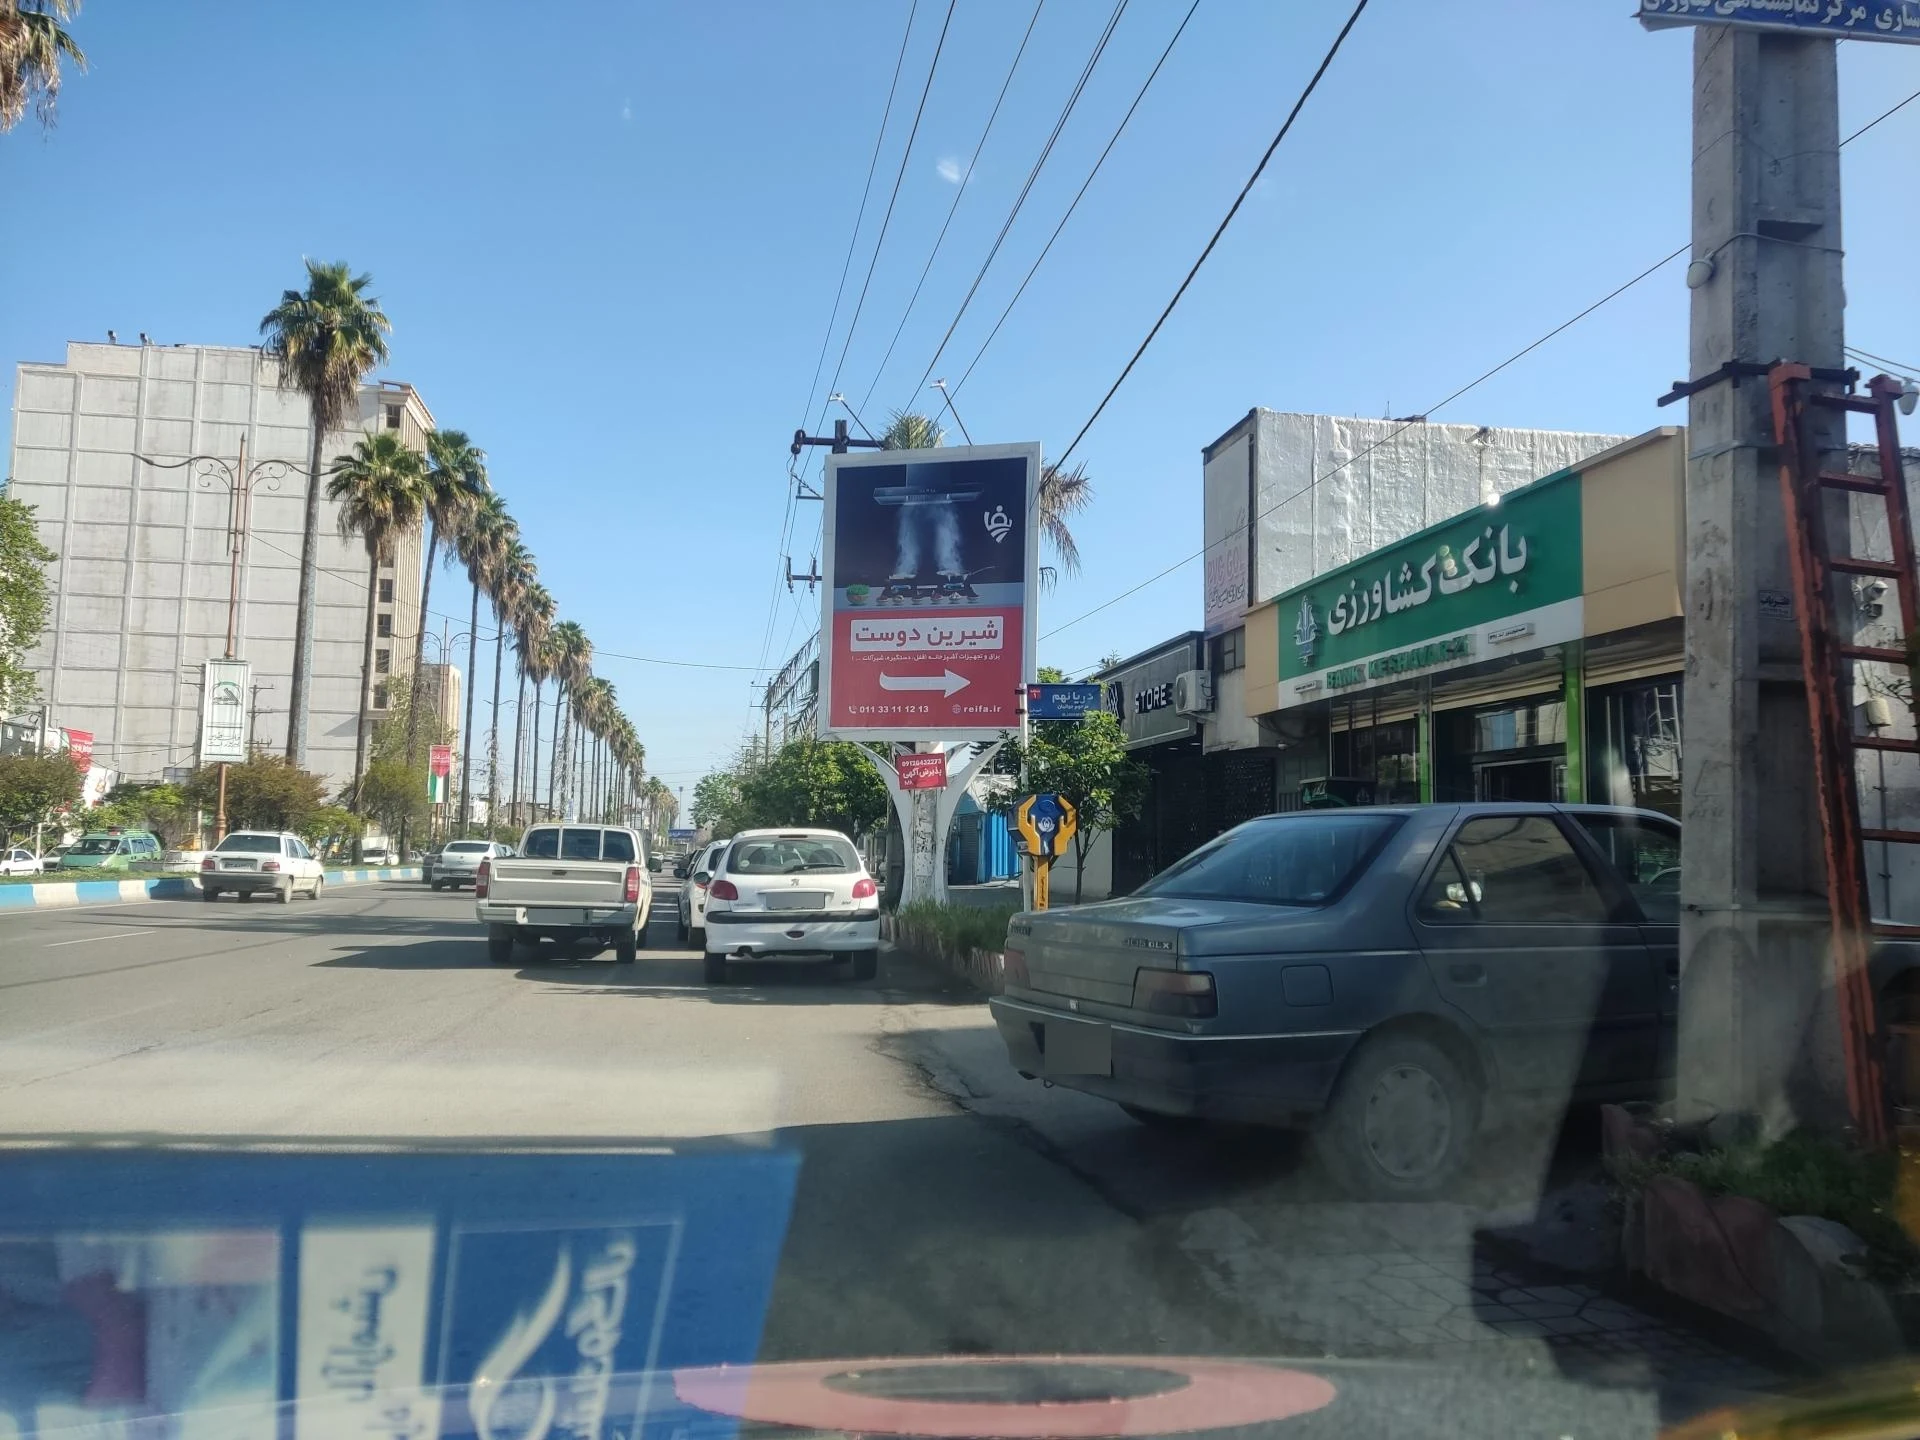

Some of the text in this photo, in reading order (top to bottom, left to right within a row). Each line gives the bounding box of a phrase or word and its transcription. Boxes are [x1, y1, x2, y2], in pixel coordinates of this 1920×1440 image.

[1438, 522, 1528, 595] بانک
[1327, 552, 1437, 636] کشاورزی
[855, 620, 999, 647] شیرین دوست
[1326, 664, 1362, 690] BANK
[859, 705, 1001, 713] 011 33 11 12 13 reifa.ir
[1134, 683, 1168, 714] STORE
[902, 766, 942, 779] پذیرش آگهی
[1148, 941, 1171, 950] GLX
